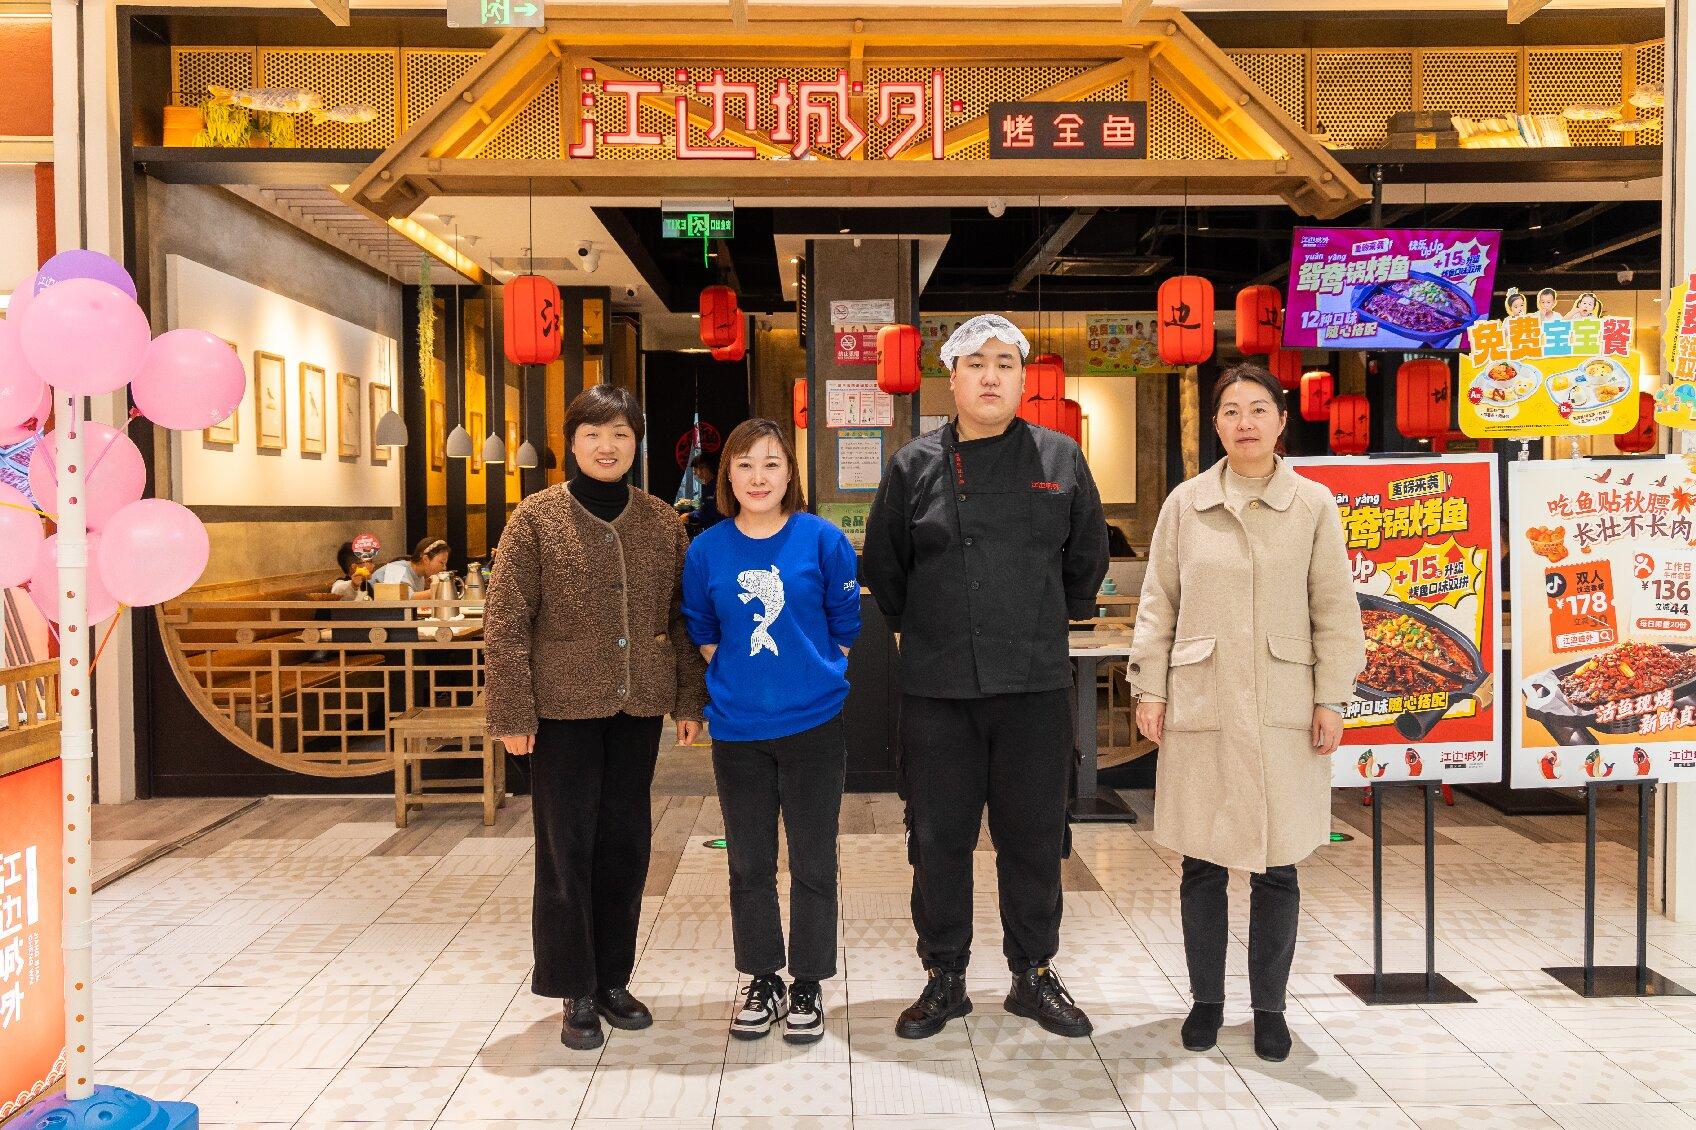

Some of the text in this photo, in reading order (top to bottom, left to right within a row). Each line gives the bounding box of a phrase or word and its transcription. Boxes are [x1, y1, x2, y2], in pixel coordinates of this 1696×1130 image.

[569, 68, 963, 160] 江边城外
[1002, 114, 1135, 147] 烤全鱼
[1297, 255, 1410, 294] 鸳鸯锅烤鱼
[1472, 317, 1631, 366] 免费宝宝餐
[1393, 475, 1439, 496] 重磅来袭
[1547, 489, 1670, 516] 吃鱼贴秋膘
[1573, 514, 1692, 546] 长壮不长肉
[1576, 570, 1603, 585] 双人
[1665, 562, 1691, 572] 工作日
[1408, 577, 1469, 599] 烤鱼口味双拼
[1440, 750, 1488, 762] 江边城外
[1669, 750, 1696, 761] 江边
